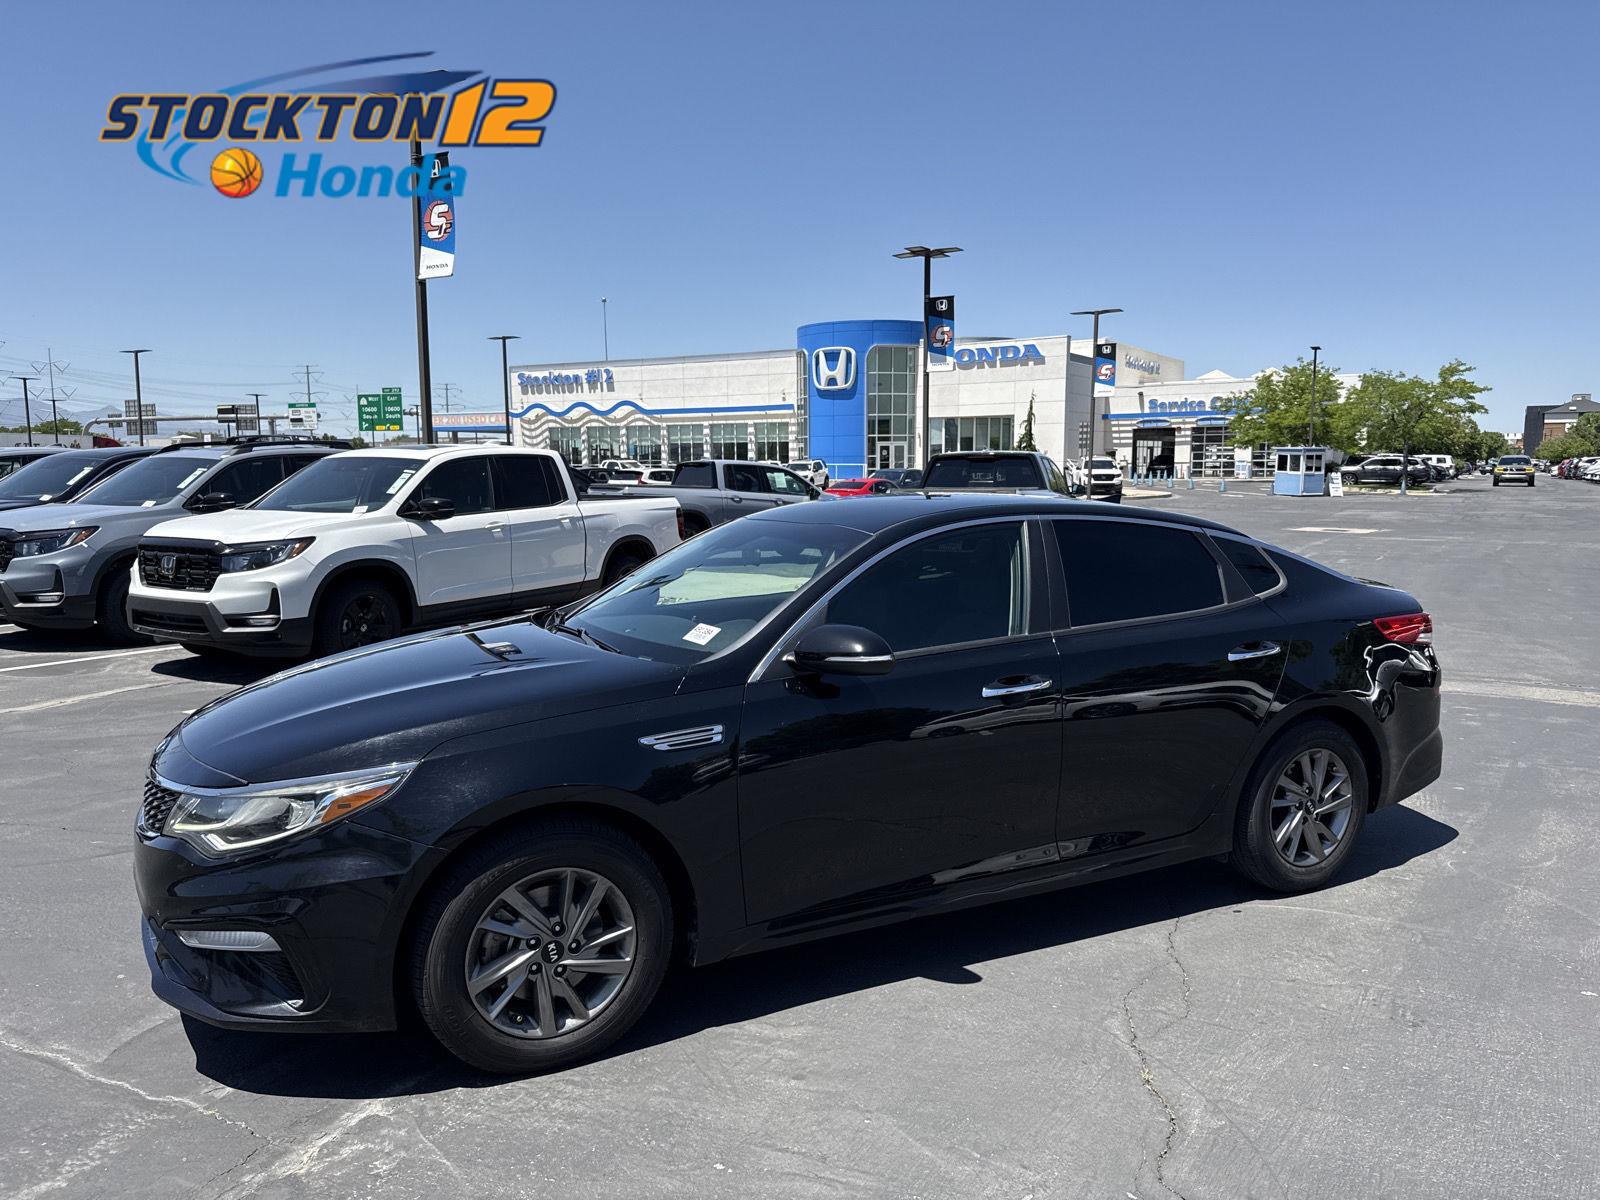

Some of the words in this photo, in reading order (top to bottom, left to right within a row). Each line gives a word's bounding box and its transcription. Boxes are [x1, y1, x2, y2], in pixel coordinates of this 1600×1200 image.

[955, 343, 1041, 365] ONDA
[517, 370, 584, 386] Stockton
[585, 367, 614, 384] #12
[1148, 397, 1206, 411] Service
[433, 415, 444, 425] ER
[446, 415, 460, 425] 200
[463, 415, 486, 424] USED
[547, 942, 558, 962] KIA
